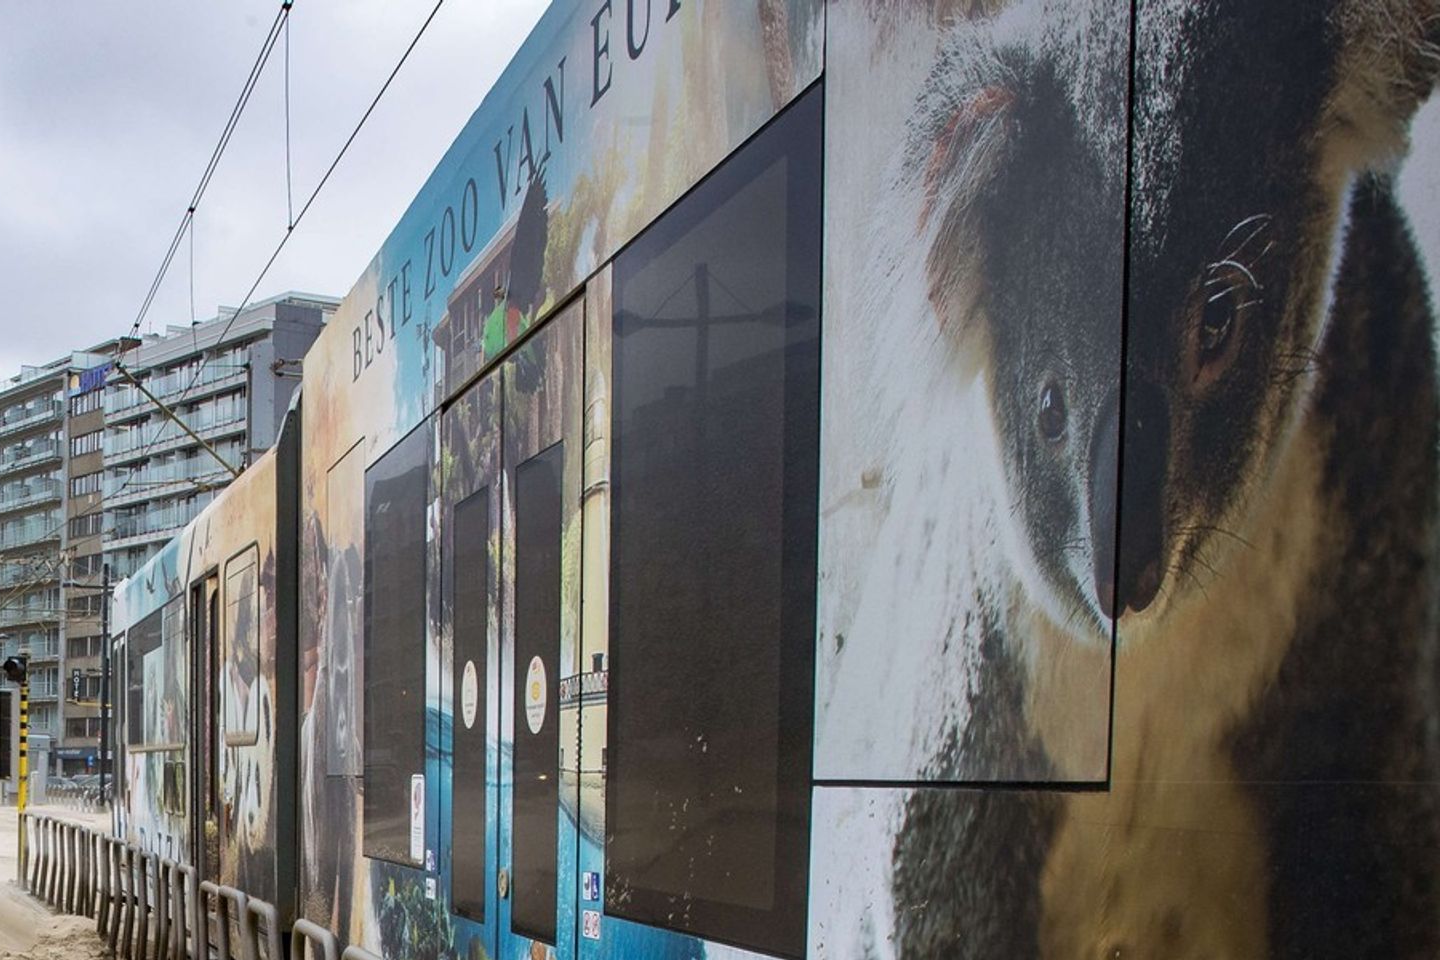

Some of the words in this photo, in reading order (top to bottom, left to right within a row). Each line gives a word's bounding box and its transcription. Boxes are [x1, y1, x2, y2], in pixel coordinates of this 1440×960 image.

[351, 259, 413, 384] BESTE
[423, 177, 478, 301] ZOO
[494, 55, 566, 210] VAN
[590, 0, 681, 108] EU
